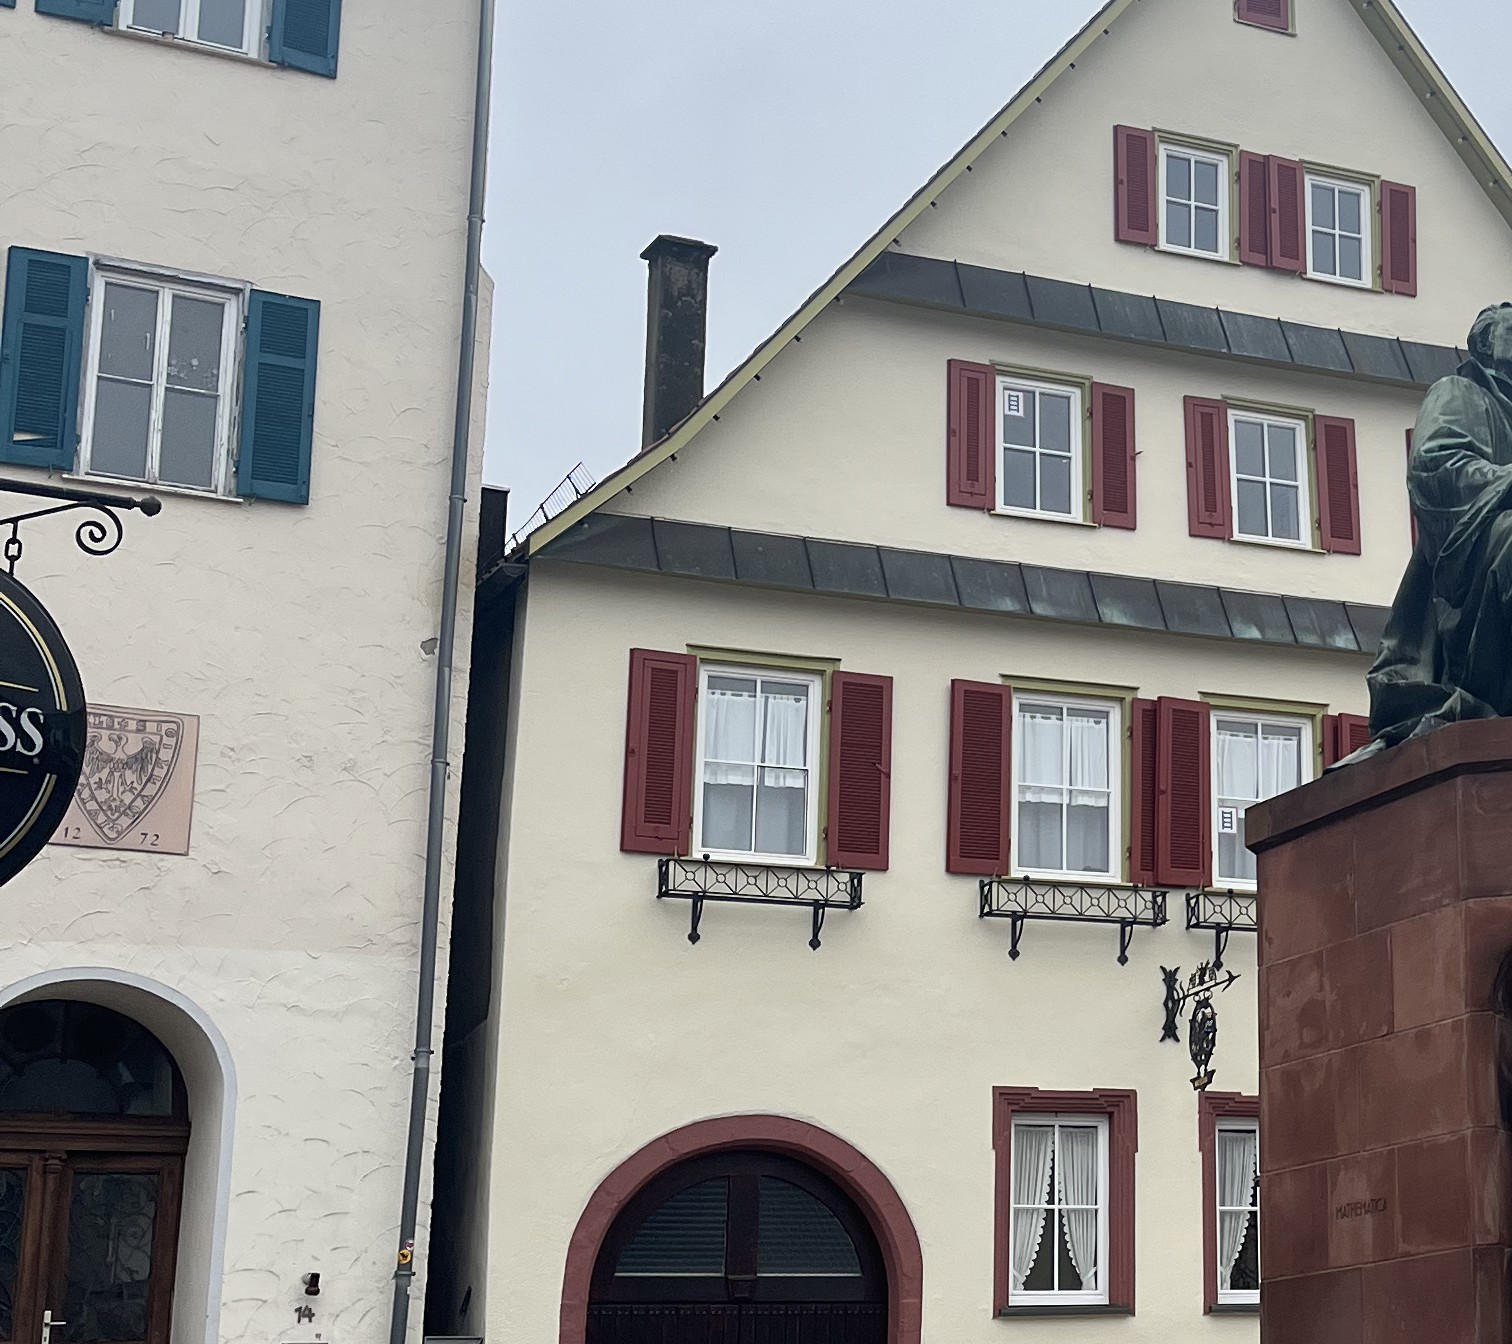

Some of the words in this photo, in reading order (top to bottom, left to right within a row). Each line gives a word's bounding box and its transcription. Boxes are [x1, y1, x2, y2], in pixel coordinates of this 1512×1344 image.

[63, 826, 81, 840] 12
[139, 832, 160, 847] 72
[294, 1304, 315, 1324] 14
